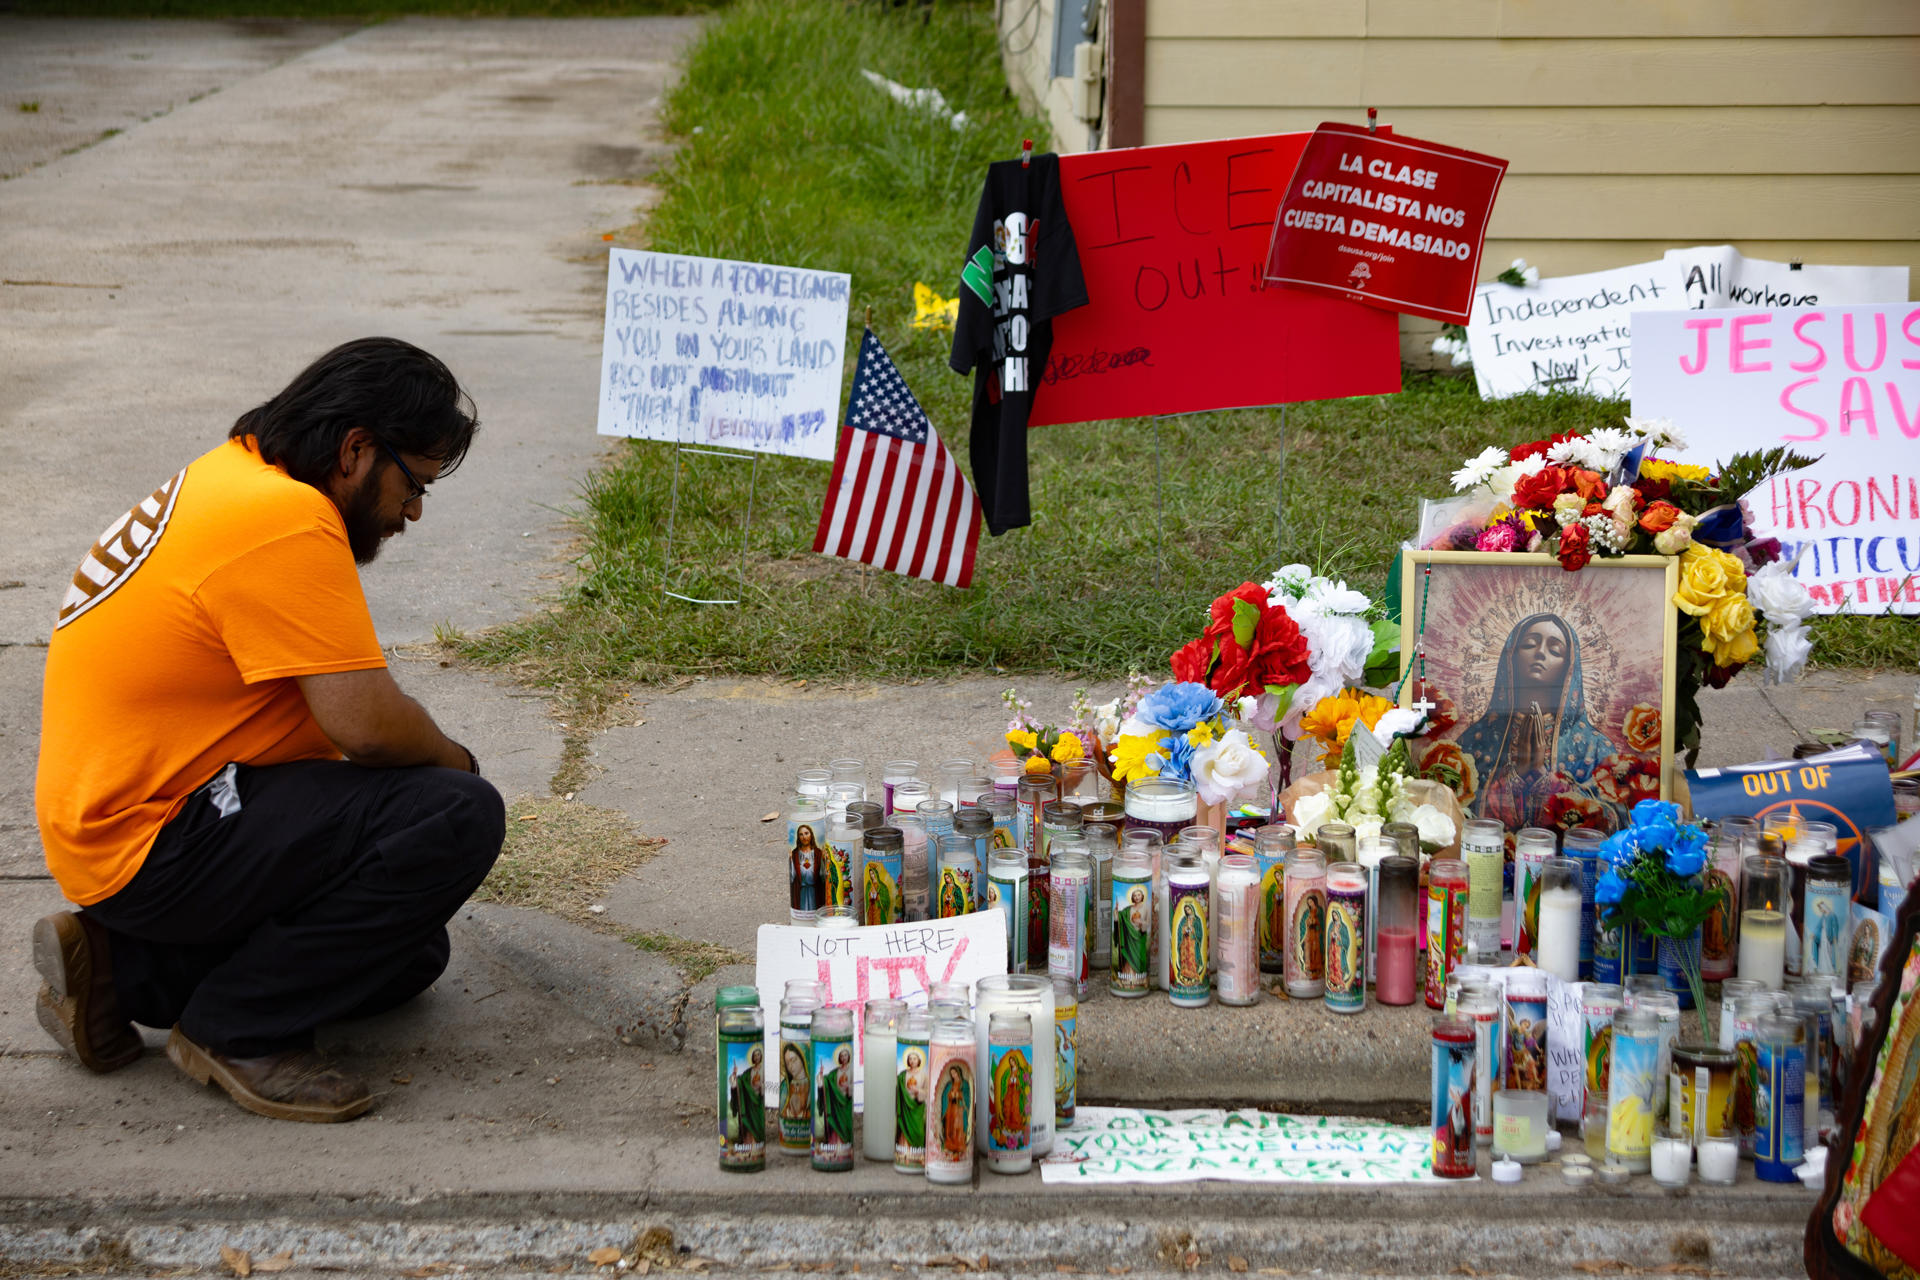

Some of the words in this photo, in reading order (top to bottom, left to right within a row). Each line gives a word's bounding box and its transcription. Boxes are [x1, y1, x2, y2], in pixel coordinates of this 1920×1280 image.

[1339, 153, 1364, 174] LA
[1368, 159, 1438, 190] CLASE
[1077, 149, 1276, 250] ICE
[1302, 180, 1422, 219] CAPITALISTA
[1425, 204, 1466, 229] NOS
[1284, 209, 1346, 235] CUESTA
[1349, 218, 1471, 261] DEMASIADO
[1338, 244, 1395, 263] dsausa.org/join
[618, 256, 703, 289] WHEN
[711, 263, 725, 288] A
[1685, 262, 1722, 295] All
[612, 289, 708, 325] RESIDES
[717, 298, 806, 333] AMONG
[1477, 278, 1665, 325] Independent
[616, 327, 662, 357] YOU
[710, 332, 767, 362] YOUR
[777, 338, 836, 369] LAND
[1679, 308, 1920, 376] JESUS
[1742, 769, 1791, 797] OUT
[1799, 765, 1833, 790] OF
[800, 935, 861, 957] NOT
[885, 928, 955, 956] HERE
